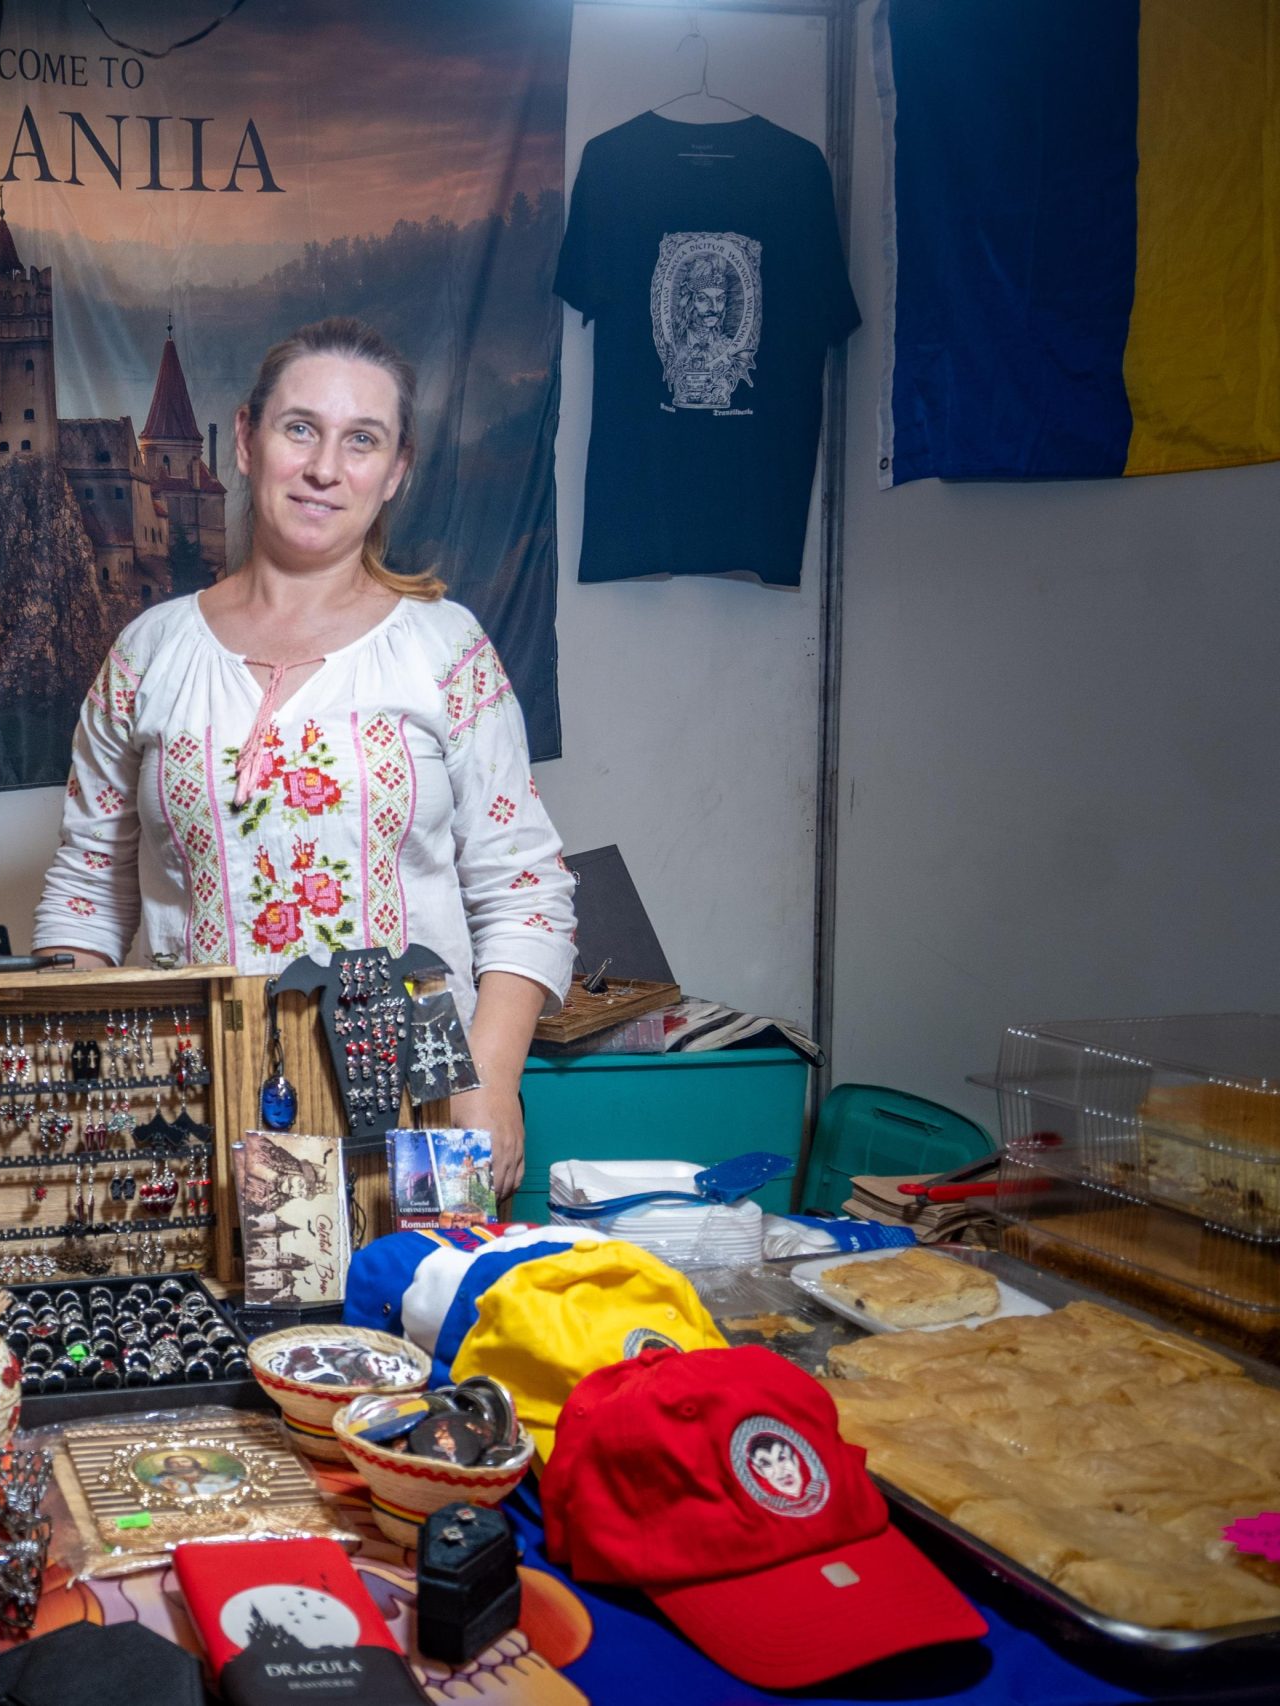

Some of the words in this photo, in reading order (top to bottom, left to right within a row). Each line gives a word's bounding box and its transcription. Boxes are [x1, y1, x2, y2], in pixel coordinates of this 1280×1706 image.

[98, 56, 145, 89] TO
[400, 1219, 440, 1229] Romania
[265, 1659, 362, 1677] DRACULA
